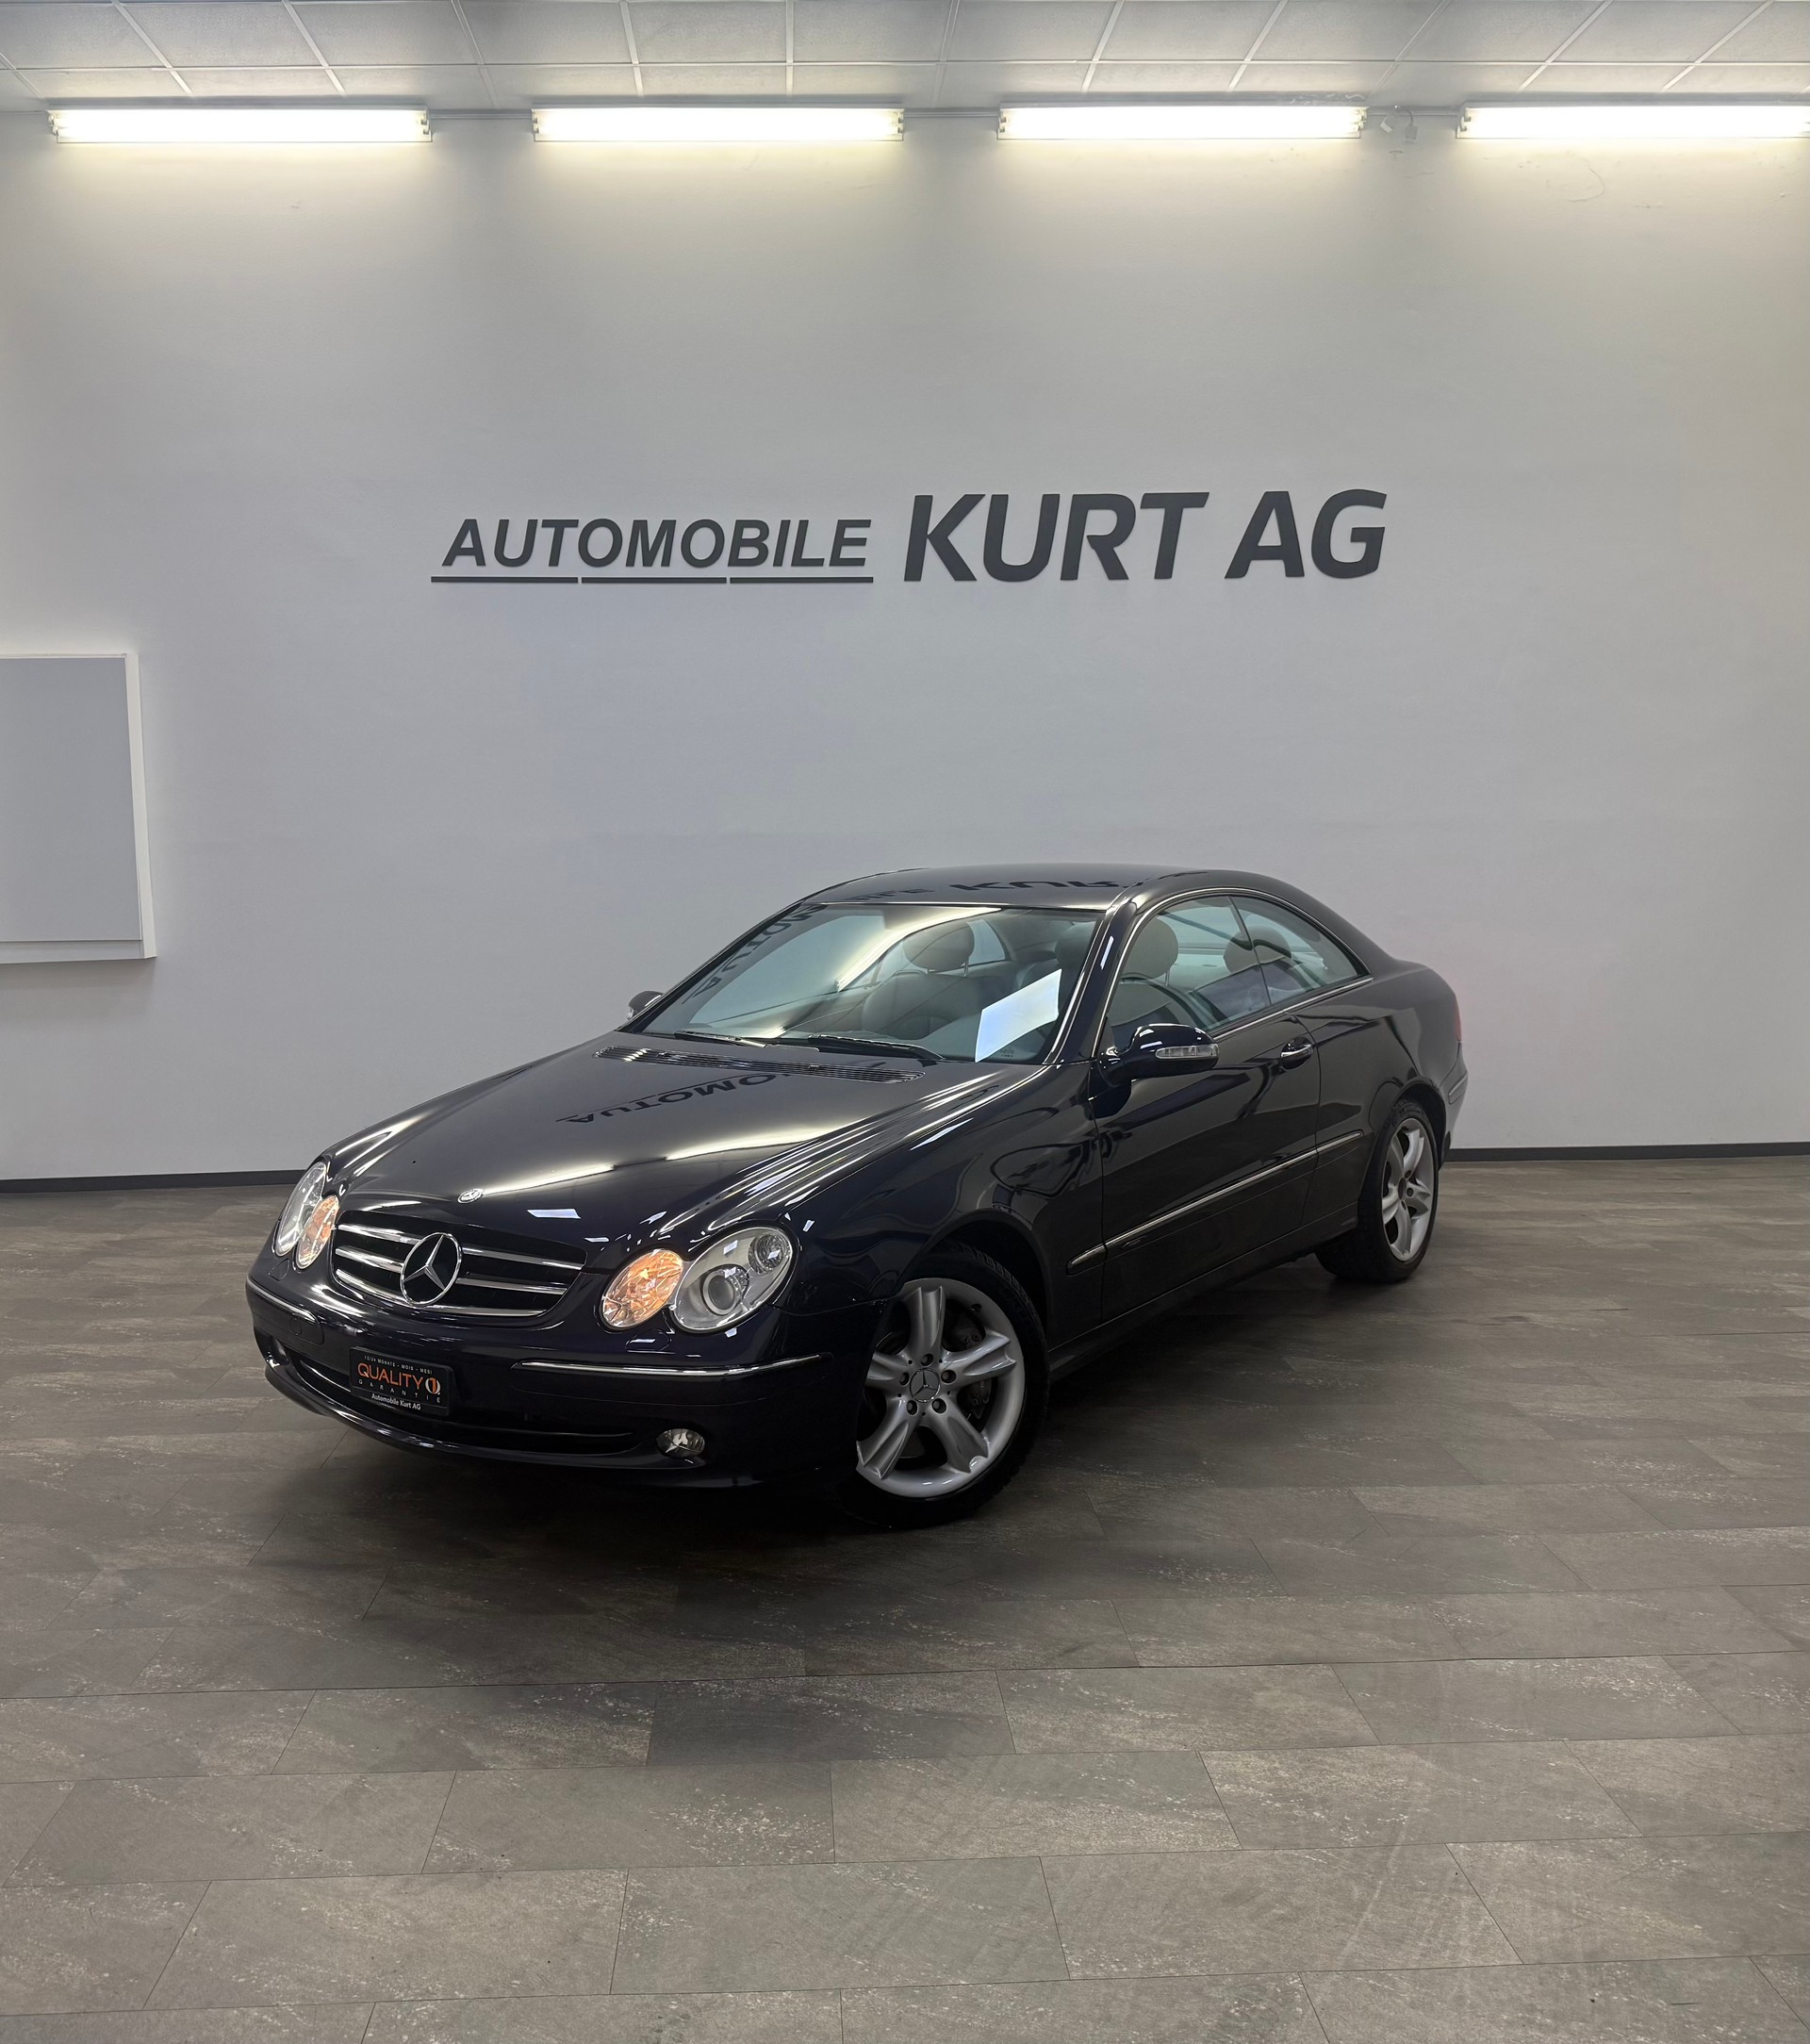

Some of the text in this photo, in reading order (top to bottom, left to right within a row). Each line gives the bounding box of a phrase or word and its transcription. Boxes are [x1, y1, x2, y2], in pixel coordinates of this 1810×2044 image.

[442, 488, 1388, 582] AUTOMOBILE KURT AG
[377, 1359, 396, 1367] MONATE
[357, 1362, 423, 1390] QUALITY
[359, 1379, 441, 1403] GARANTIE
[370, 1393, 421, 1410] Automobile Kurt AG
